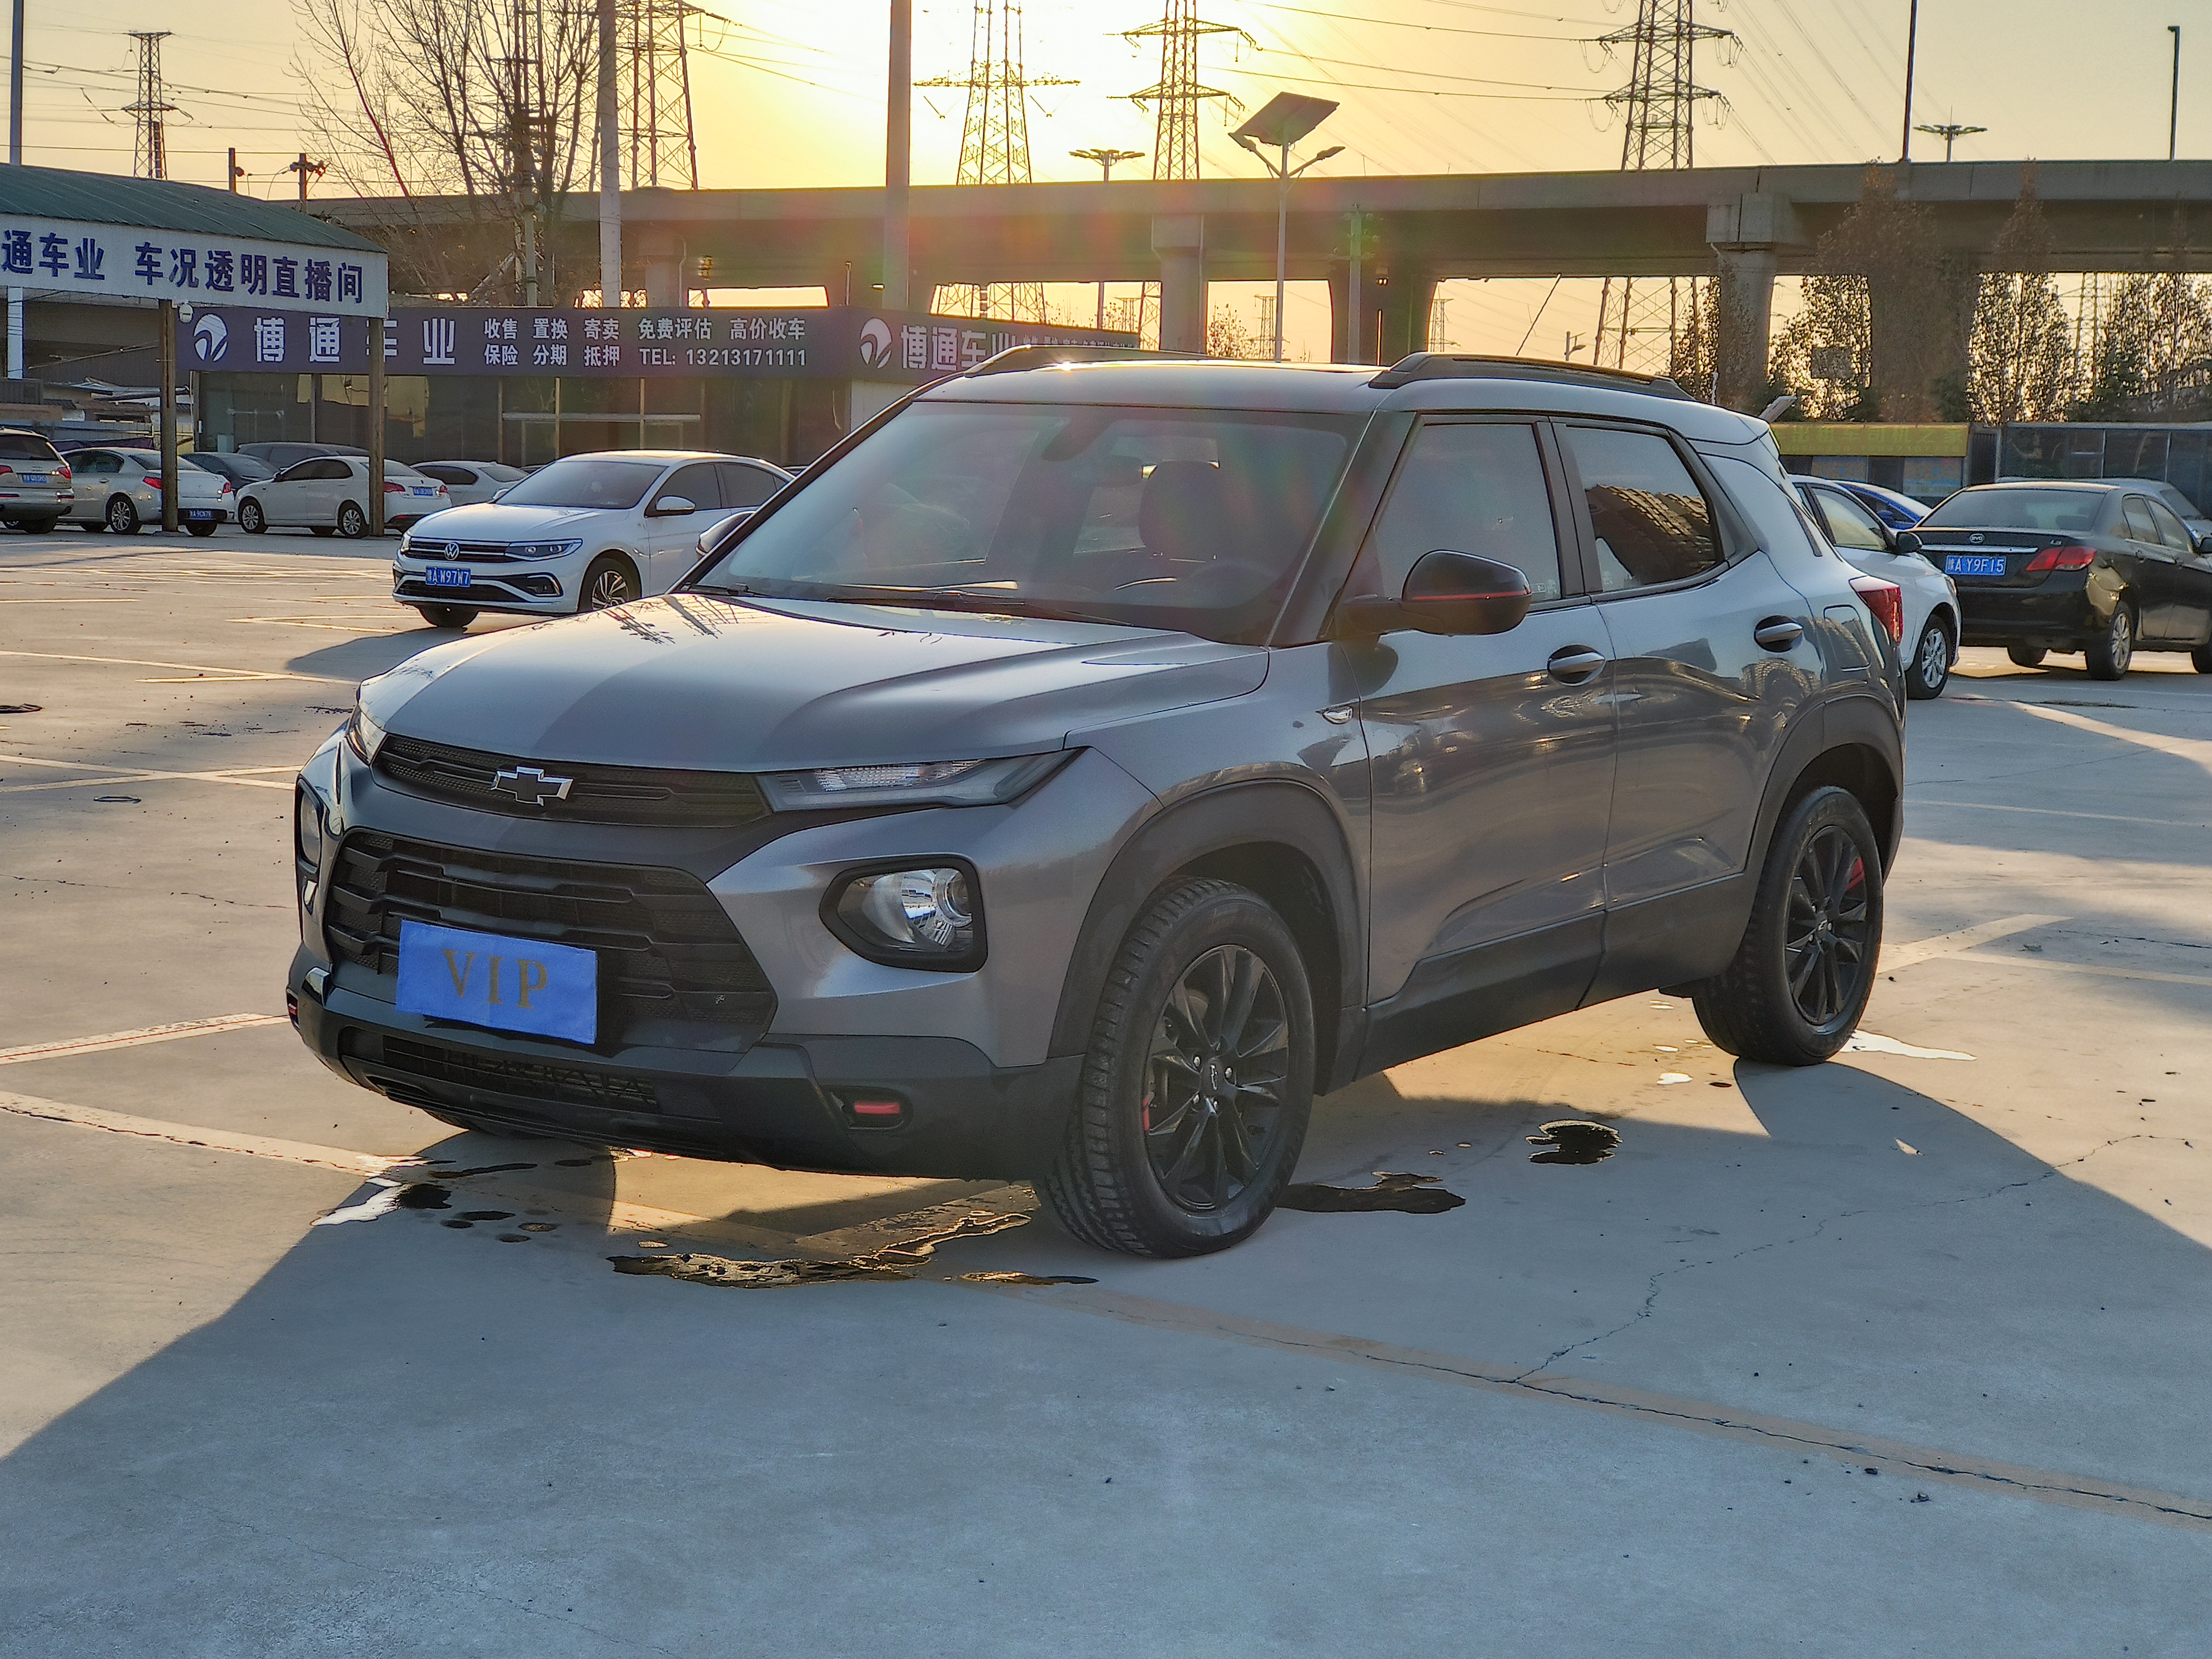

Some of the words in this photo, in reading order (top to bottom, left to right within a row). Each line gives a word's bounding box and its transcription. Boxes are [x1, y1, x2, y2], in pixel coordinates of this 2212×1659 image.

[2, 230, 105, 280] 通车业
[135, 241, 363, 304] 车况透明直播间
[484, 318, 518, 340] 收售
[533, 318, 568, 340] 置换
[584, 317, 620, 340] 寄卖
[638, 317, 712, 340] 免费评估
[730, 317, 806, 340] 高价收车
[484, 343, 519, 366] 保险
[533, 344, 567, 366] 分期
[584, 345, 620, 366] 抵押
[639, 348, 676, 366] TEL:
[686, 348, 806, 366] 13213171111
[442, 949, 548, 1009] VIP
